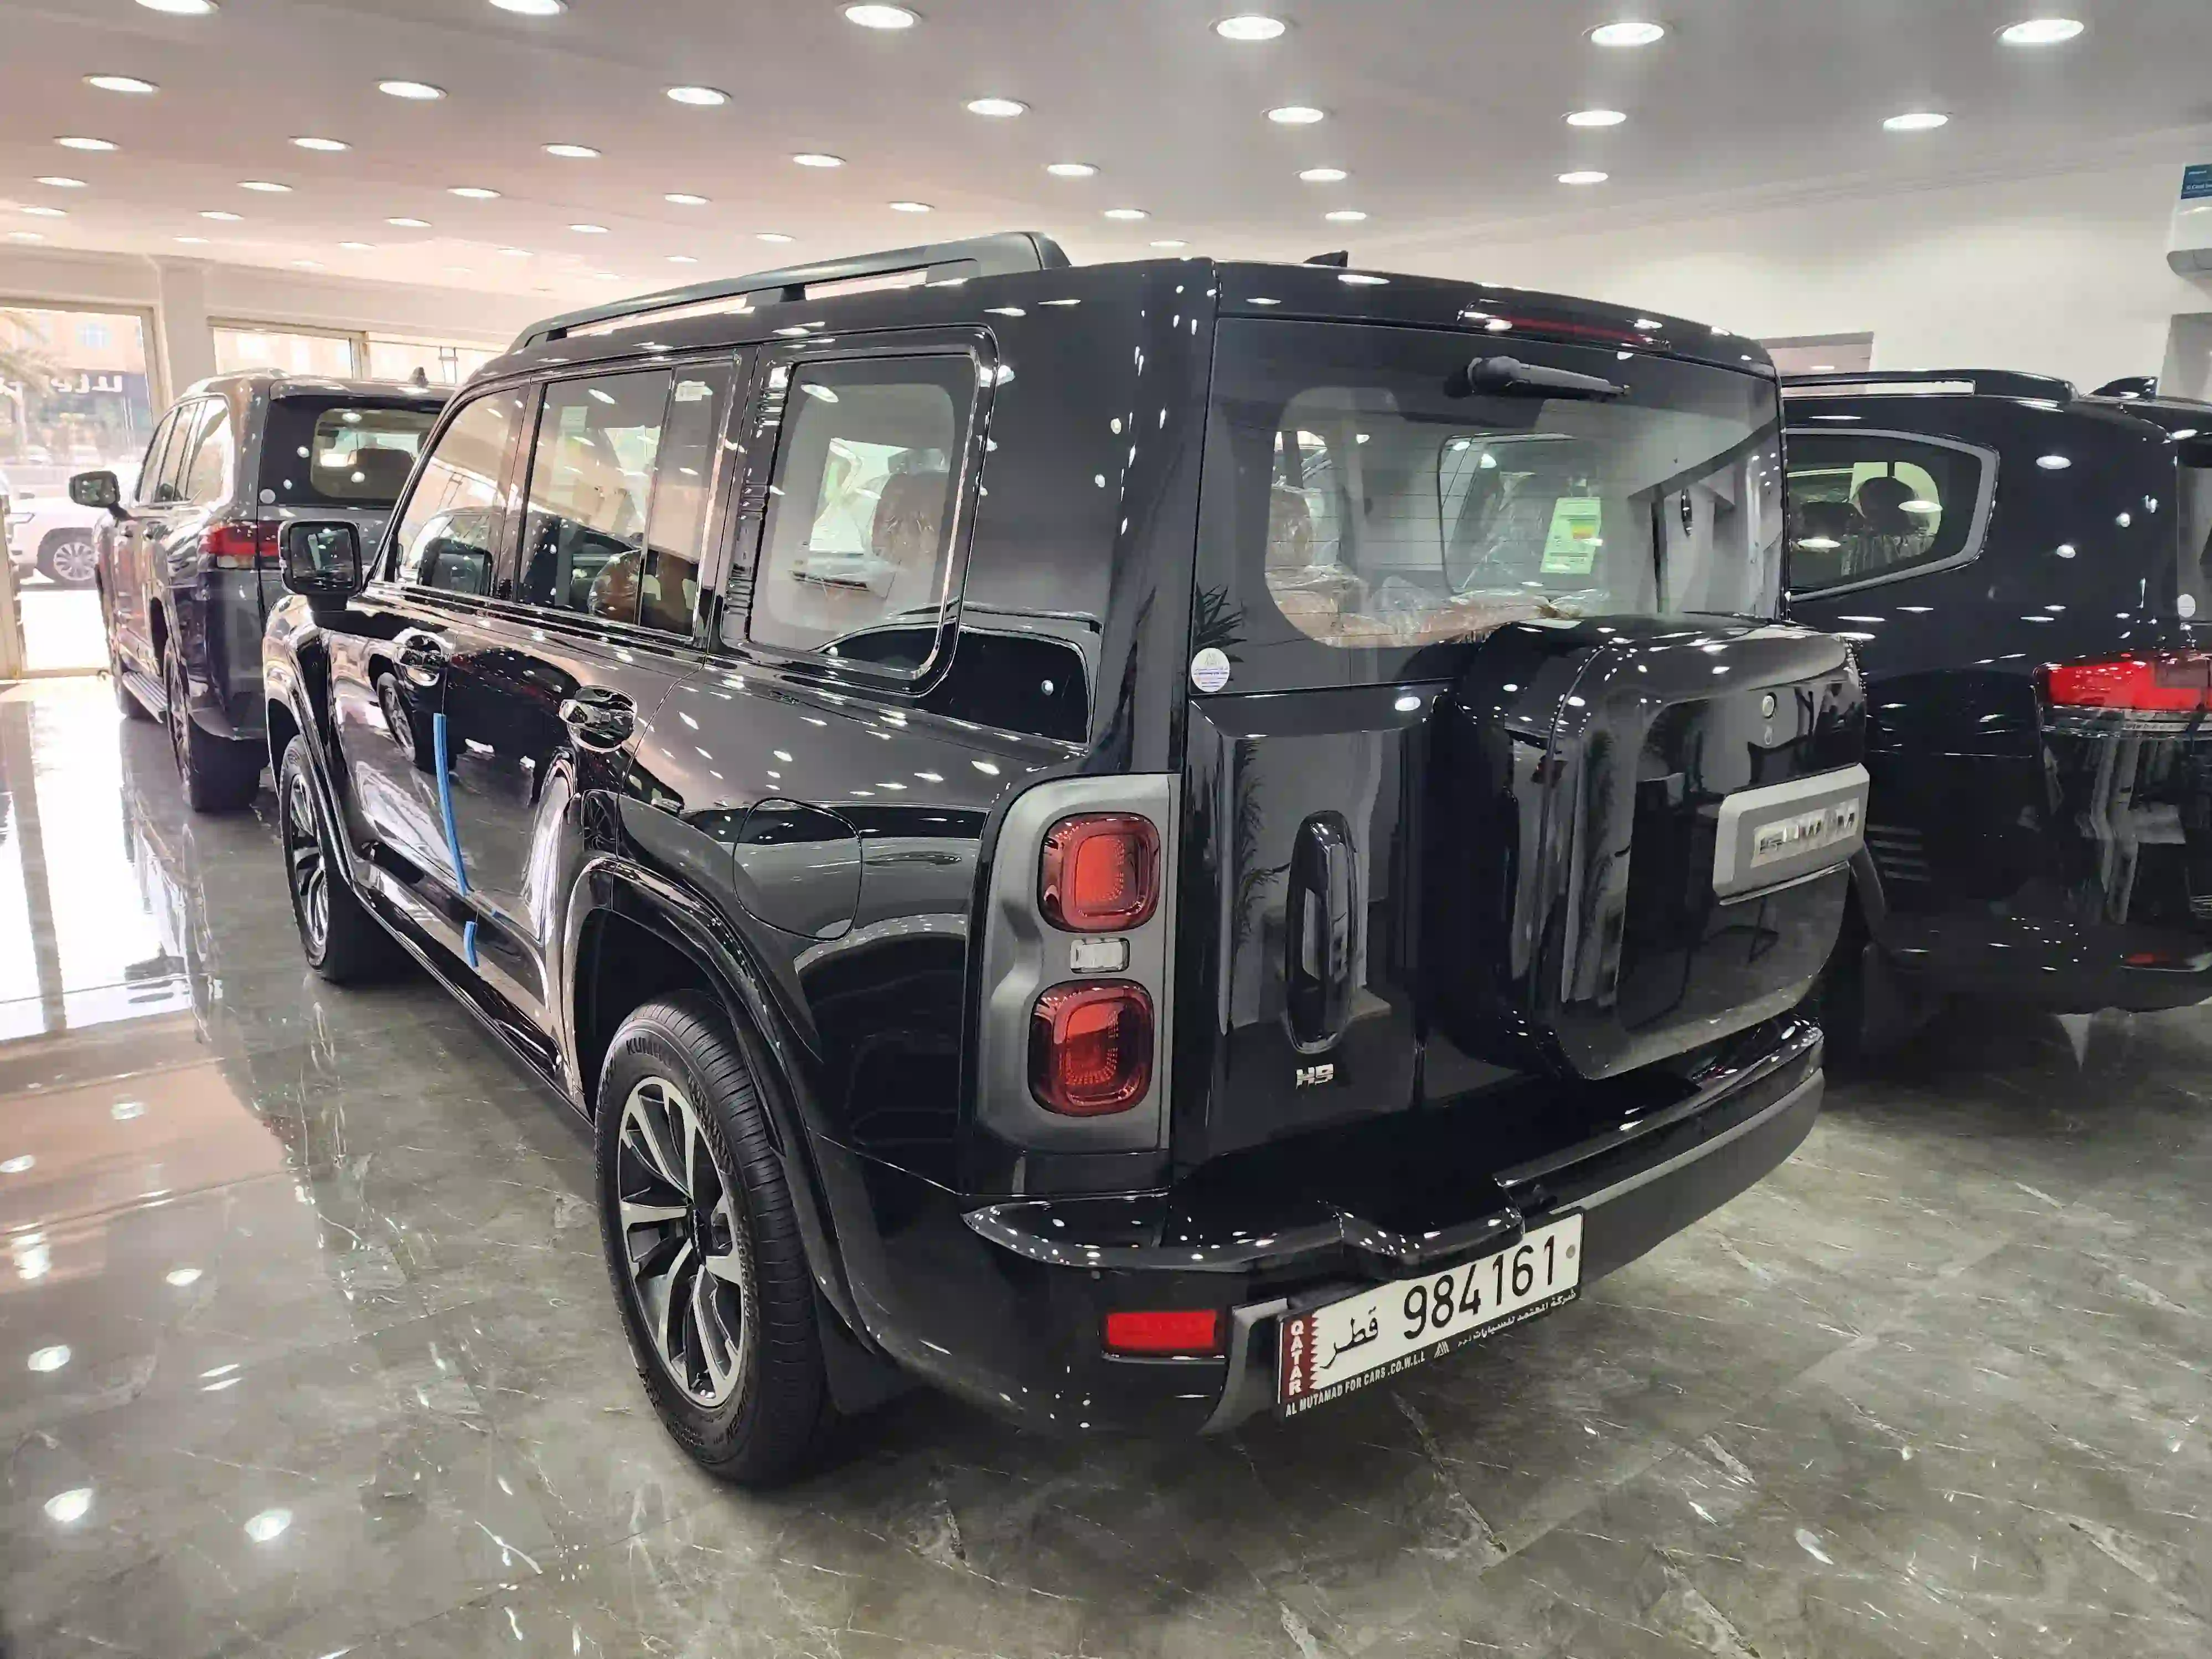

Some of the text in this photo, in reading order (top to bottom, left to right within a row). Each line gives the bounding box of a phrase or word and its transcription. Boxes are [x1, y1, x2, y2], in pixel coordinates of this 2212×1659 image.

[1296, 1063, 1334, 1089] H9
[1403, 1235, 1555, 1340] 984161
[1289, 1320, 1305, 1396] QATAR
[1320, 1306, 1378, 1369] قطر
[1285, 1403, 1298, 1418] AL
[1299, 1386, 1343, 1412] MUTAMAD
[1345, 1378, 1362, 1393] FOR
[1363, 1367, 1386, 1385] CARS
